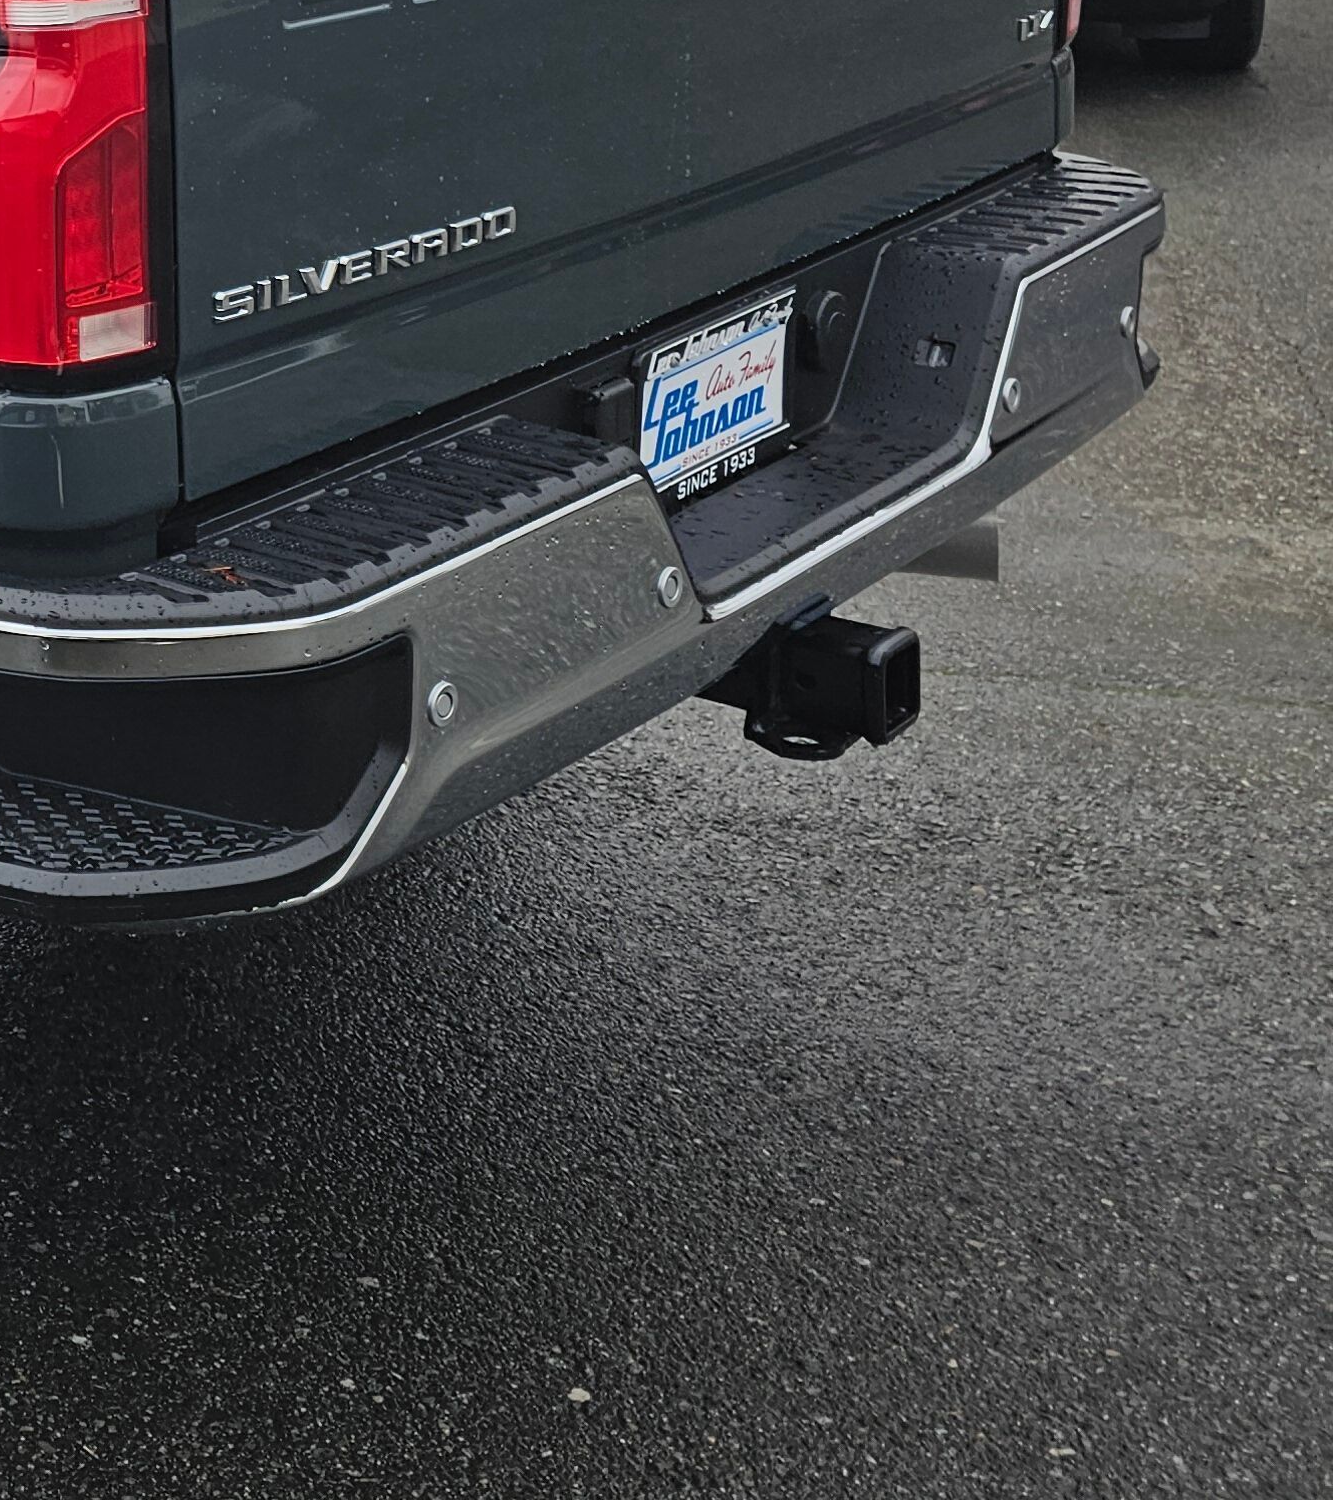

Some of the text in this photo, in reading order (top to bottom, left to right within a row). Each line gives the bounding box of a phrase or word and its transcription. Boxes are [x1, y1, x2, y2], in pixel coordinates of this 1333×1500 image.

[212, 205, 517, 324] SILVERADO
[705, 340, 777, 400] Auto Family
[643, 377, 699, 432] Lee
[644, 385, 766, 468] Johnson
[676, 447, 756, 501] SINCE 1933
[682, 433, 738, 468] SINCE 1933
